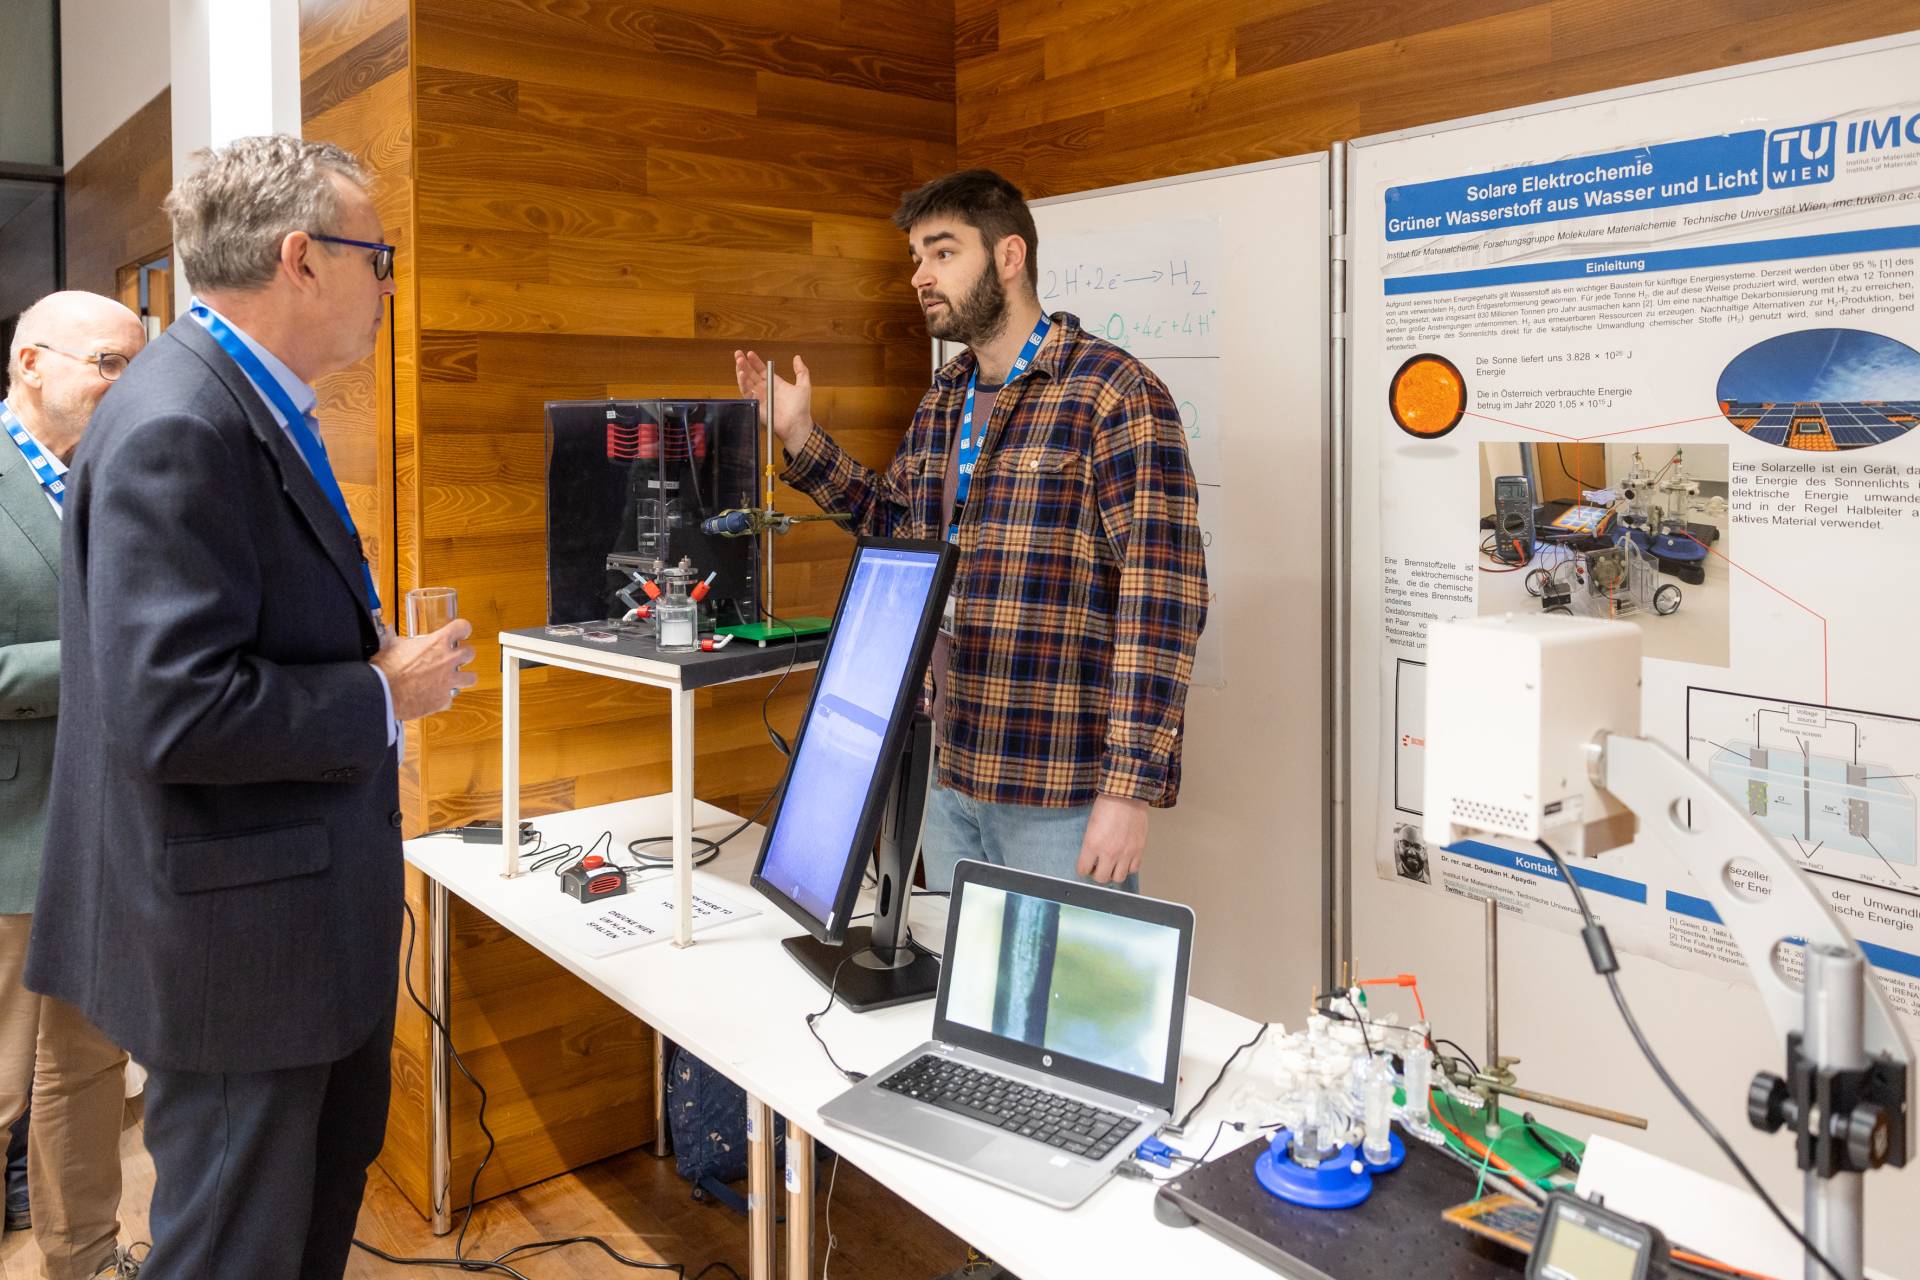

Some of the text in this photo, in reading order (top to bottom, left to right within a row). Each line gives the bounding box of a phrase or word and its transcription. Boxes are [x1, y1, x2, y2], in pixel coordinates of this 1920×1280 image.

[1772, 125, 1831, 165] TU
[1466, 160, 1653, 202] Solare Elektrochemie
[1772, 164, 1830, 184] WIEN
[1388, 167, 1758, 234] Grüner Wasserstoff aus Wasser und Licht
[1386, 251, 1410, 260] Institut
[1411, 249, 1420, 257] für
[1482, 234, 1555, 248] Forschungsgruppe
[1558, 228, 1604, 240] Molekulare
[1682, 212, 1737, 226] Technische
[1740, 204, 1796, 219] Universität
[1800, 202, 1828, 213] Wien,
[1586, 260, 1646, 273] Einleitung
[1510, 288, 1550, 298] Wasserstoff
[1576, 284, 1608, 292] wichtiger
[1610, 281, 1642, 289] Baustein
[1656, 277, 1688, 286] künftige
[1760, 268, 1792, 277] Derzeit
[1794, 266, 1827, 274] werden
[1829, 263, 1850, 271] über
[1852, 261, 1864, 269] 95
[1868, 260, 1877, 268] %
[1880, 259, 1892, 269] [1]
[1895, 258, 1914, 266] des
[1457, 303, 1474, 311] durch
[1594, 293, 1611, 302] jede
[1666, 287, 1679, 295] auf
[1680, 286, 1702, 294] diese
[1704, 284, 1730, 292] Weise
[1732, 280, 1775, 292] produziert
[1802, 276, 1834, 284] werden
[1838, 274, 1860, 282] etwa
[1864, 272, 1874, 280] 12
[1878, 270, 1914, 278] Tonnen
[1547, 307, 1558, 315] pro
[1560, 305, 1576, 313] Jahr
[1578, 303, 1620, 311] ausmachen
[1622, 301, 1641, 309] kann
[1673, 297, 1690, 305] eine
[1692, 293, 1738, 303] nachhaltige
[1741, 289, 1818, 299] Dekarbonisierung
[1820, 286, 1834, 294] mit
[1700, 303, 1749, 313] Nachhaltige
[1752, 300, 1805, 309] Alternativen
[1898, 291, 1914, 300] bei
[1418, 332, 1441, 341] Energie
[1458, 329, 1498, 338] Sonnenlichts
[1501, 327, 1520, 335] direkt
[1596, 321, 1645, 329] Umwandlung
[1649, 317, 1694, 326] chemischer
[1698, 315, 1722, 323] Stoffe
[1749, 311, 1782, 321] genutzt
[1814, 308, 1834, 317] sind
[1839, 307, 1866, 315] daher
[1871, 303, 1915, 314] dringend
[1476, 356, 1488, 365] Die
[1492, 356, 1518, 364] Sonne
[1521, 355, 1544, 364] liefert
[1566, 352, 1591, 362] 3.828
[1476, 368, 1506, 378] Energie
[1477, 388, 1632, 399] Die in Österreich verbrauchte Energie
[1477, 401, 1501, 410] betrug
[1503, 401, 1512, 409] im
[1514, 400, 1532, 409] Jahr
[1534, 400, 1556, 409] 2020
[1607, 400, 1612, 408] J
[1732, 462, 1899, 476] Eine Solarzelle ist ein Gerät,
[1732, 475, 1910, 488] die Energie des Sonnenlichts
[1732, 488, 1848, 502] elektrische Energie
[1732, 501, 1751, 511] und
[1759, 502, 1769, 511] in
[1777, 503, 1796, 512] der
[1805, 504, 1838, 515] Regel
[1847, 505, 1902, 517] Halbleiter
[1732, 514, 1884, 530] aktives Material verwendet.
[1385, 557, 1398, 565] Eine
[1404, 559, 1456, 570] Brennstoffzelle
[1411, 570, 1473, 582] elektrochemische
[1419, 580, 1473, 592] die chemische
[1385, 587, 1472, 603] Energie eines Brennstoffs
[1395, 617, 1409, 626] Paar
[1441, 855, 1450, 863] Dr.
[1474, 864, 1502, 877] Dogukan
[1515, 856, 1558, 876] Kontakt
[1832, 890, 1851, 902] der
[1669, 916, 1677, 925] [1]
[1868, 912, 1914, 931] Energie
[586, 922, 620, 938] SPALTEN
[636, 924, 655, 934] HIER
[1669, 933, 1677, 941] [2]
[1680, 935, 1692, 943] The
[1693, 939, 1714, 950] Future
